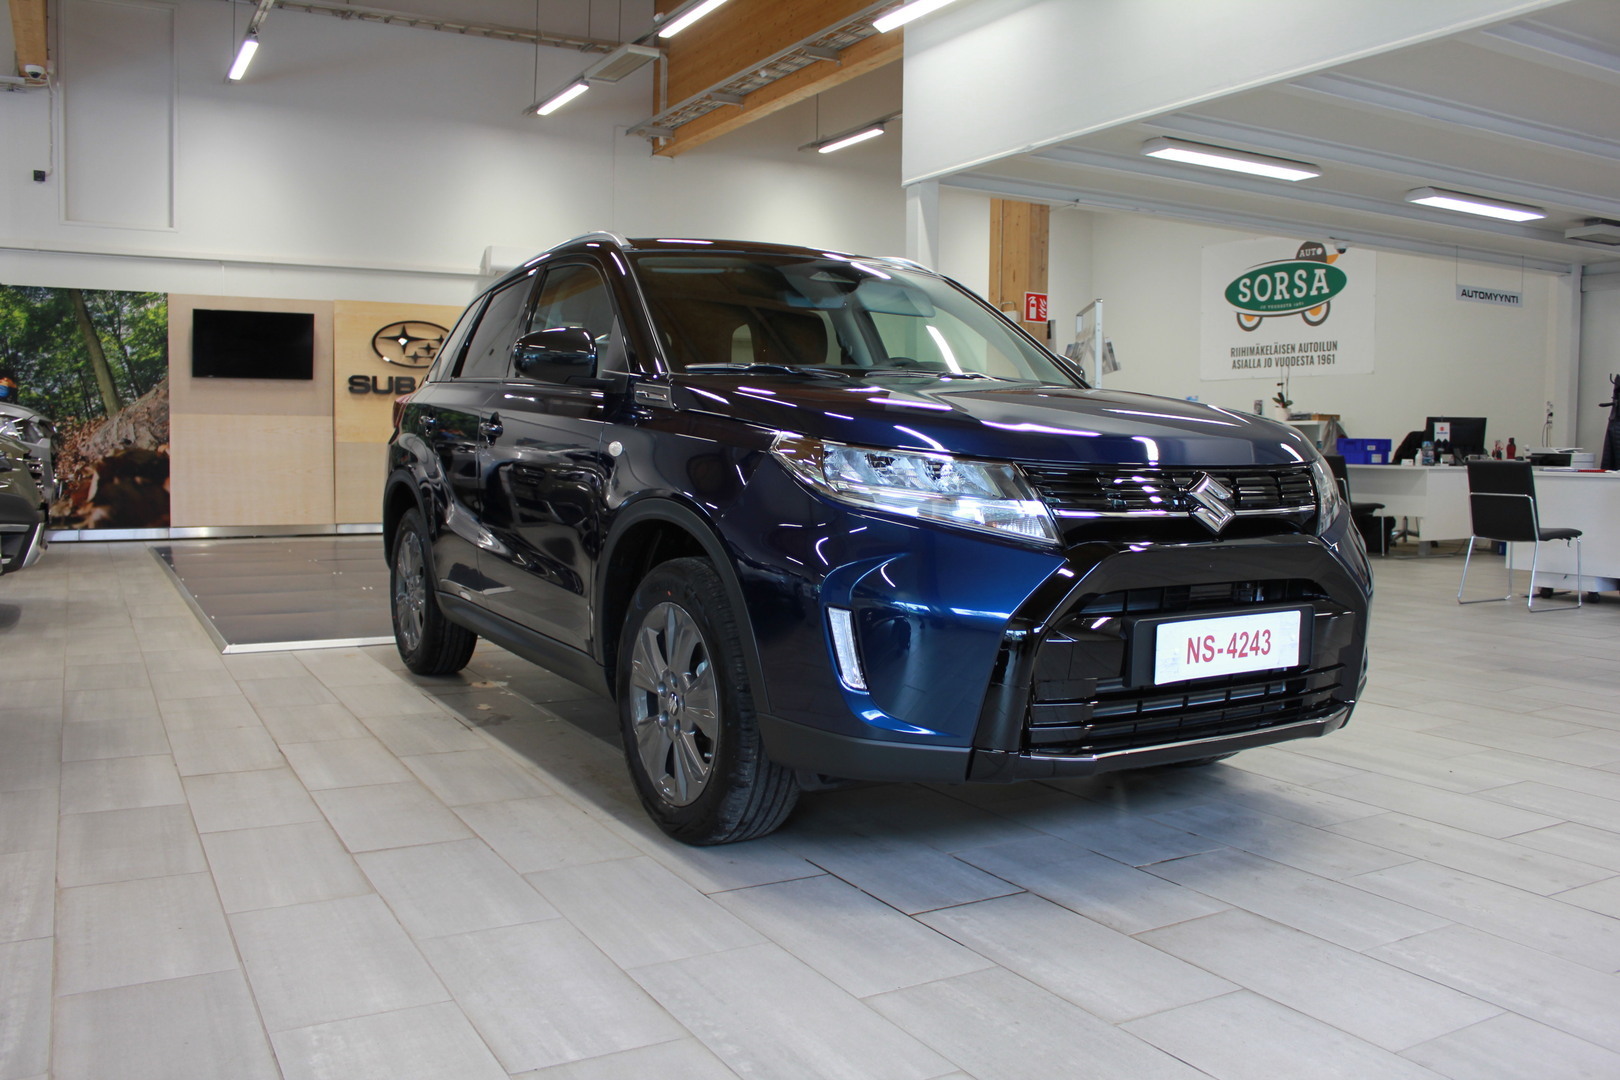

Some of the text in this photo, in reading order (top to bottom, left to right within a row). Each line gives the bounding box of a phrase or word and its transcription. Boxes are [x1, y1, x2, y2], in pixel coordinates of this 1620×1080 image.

[1299, 247, 1323, 258] AUTO
[1238, 269, 1330, 302] SORSA
[1461, 289, 1519, 304] AUTOMYYNTI
[1230, 340, 1338, 357] RIIHIMÄKELÄISEN AUTOILUN
[1231, 354, 1335, 369] ASIALLA JO VUODESTA 1961
[348, 375, 425, 395] SUB
[1186, 629, 1272, 664] NS-4243
